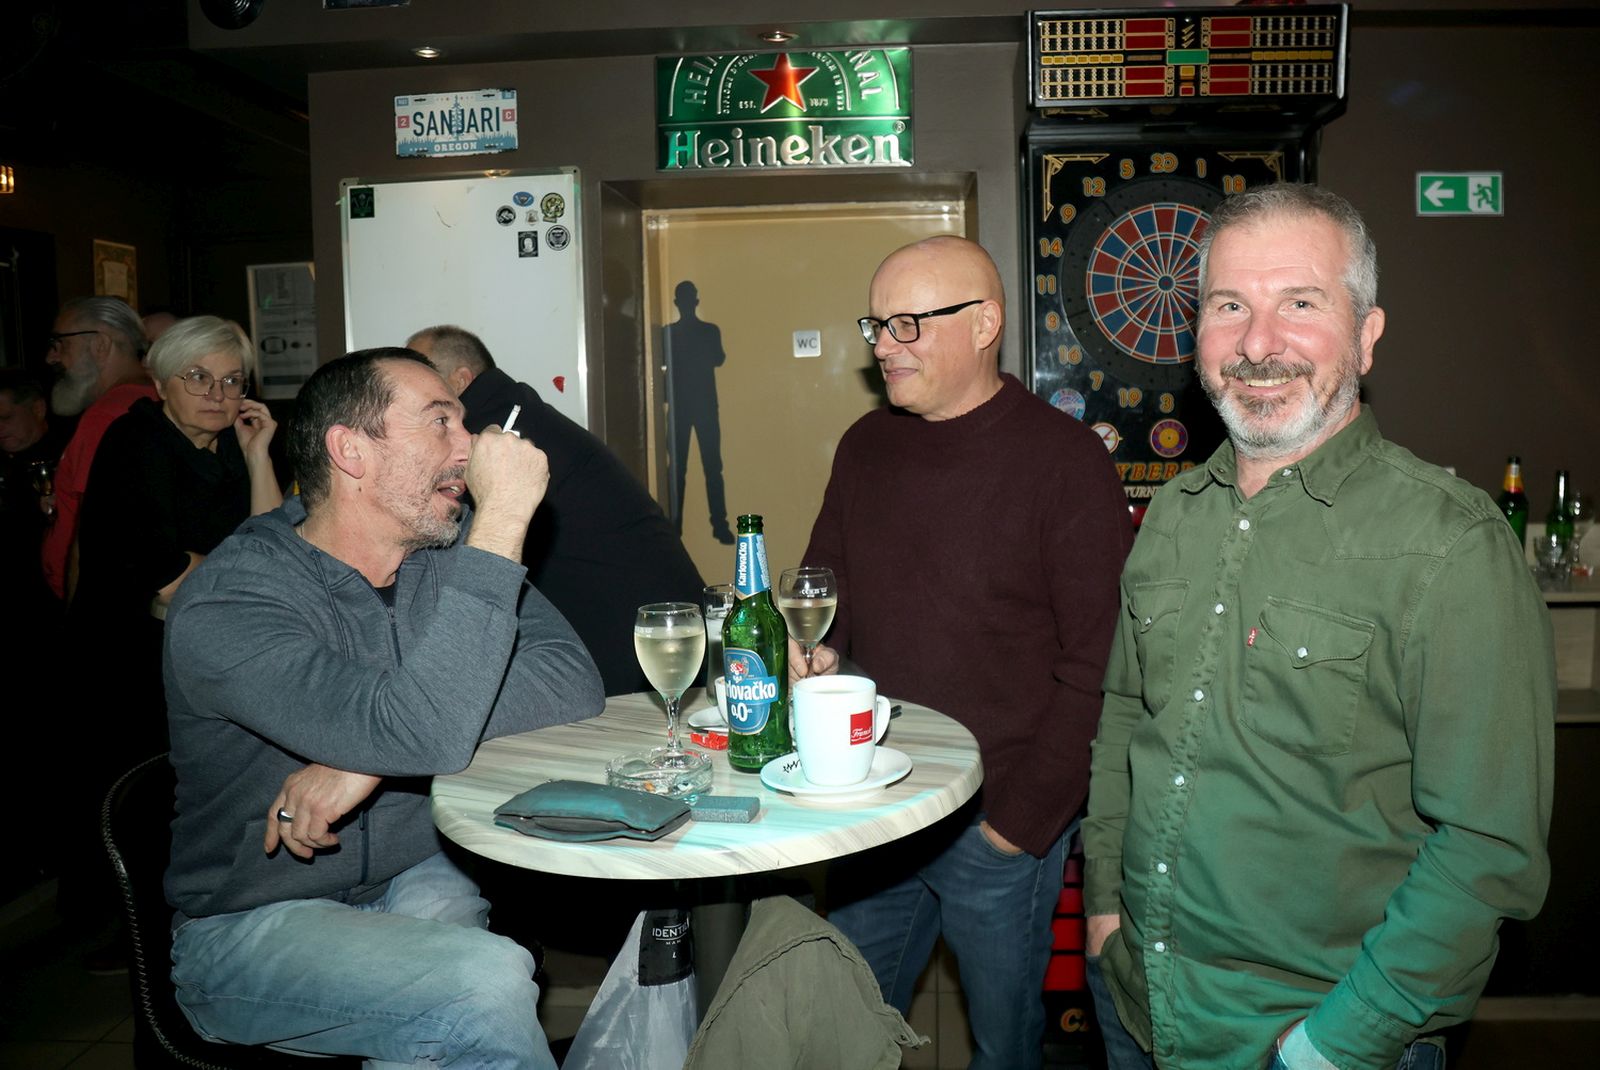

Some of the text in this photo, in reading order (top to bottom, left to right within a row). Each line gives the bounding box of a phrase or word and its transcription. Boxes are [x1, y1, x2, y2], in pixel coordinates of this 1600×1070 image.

[412, 107, 501, 137] SANJARI
[434, 141, 478, 152] OREGON
[665, 124, 911, 169] Heineken
[1119, 158, 1135, 179] 5
[1150, 153, 1178, 173] 20
[1196, 158, 1207, 178] 1
[1082, 176, 1106, 197] 12
[1223, 175, 1246, 194] 18
[1060, 204, 1077, 224] 9
[1040, 237, 1064, 258] 14
[1036, 274, 1057, 295] 11
[1045, 311, 1061, 332] 8
[797, 337, 817, 349] WC
[1058, 344, 1082, 365] 16
[1089, 370, 1104, 391] 7
[1118, 388, 1142, 408] 19
[1159, 392, 1175, 414] 3
[738, 541, 748, 586] Karlovačko
